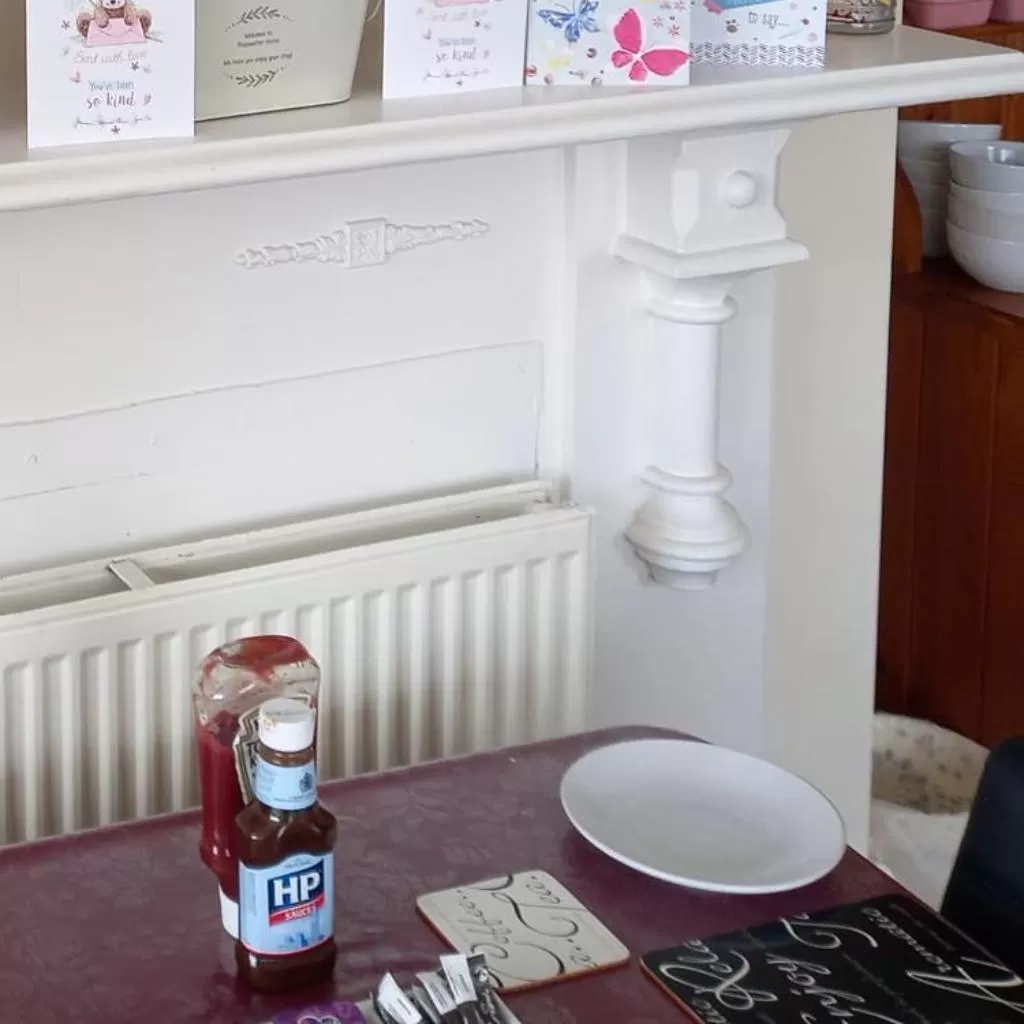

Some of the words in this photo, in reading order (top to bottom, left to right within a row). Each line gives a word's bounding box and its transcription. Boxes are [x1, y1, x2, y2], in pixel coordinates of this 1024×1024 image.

[86, 95, 102, 110] so
[106, 90, 136, 109] kind
[273, 871, 321, 907] HP
